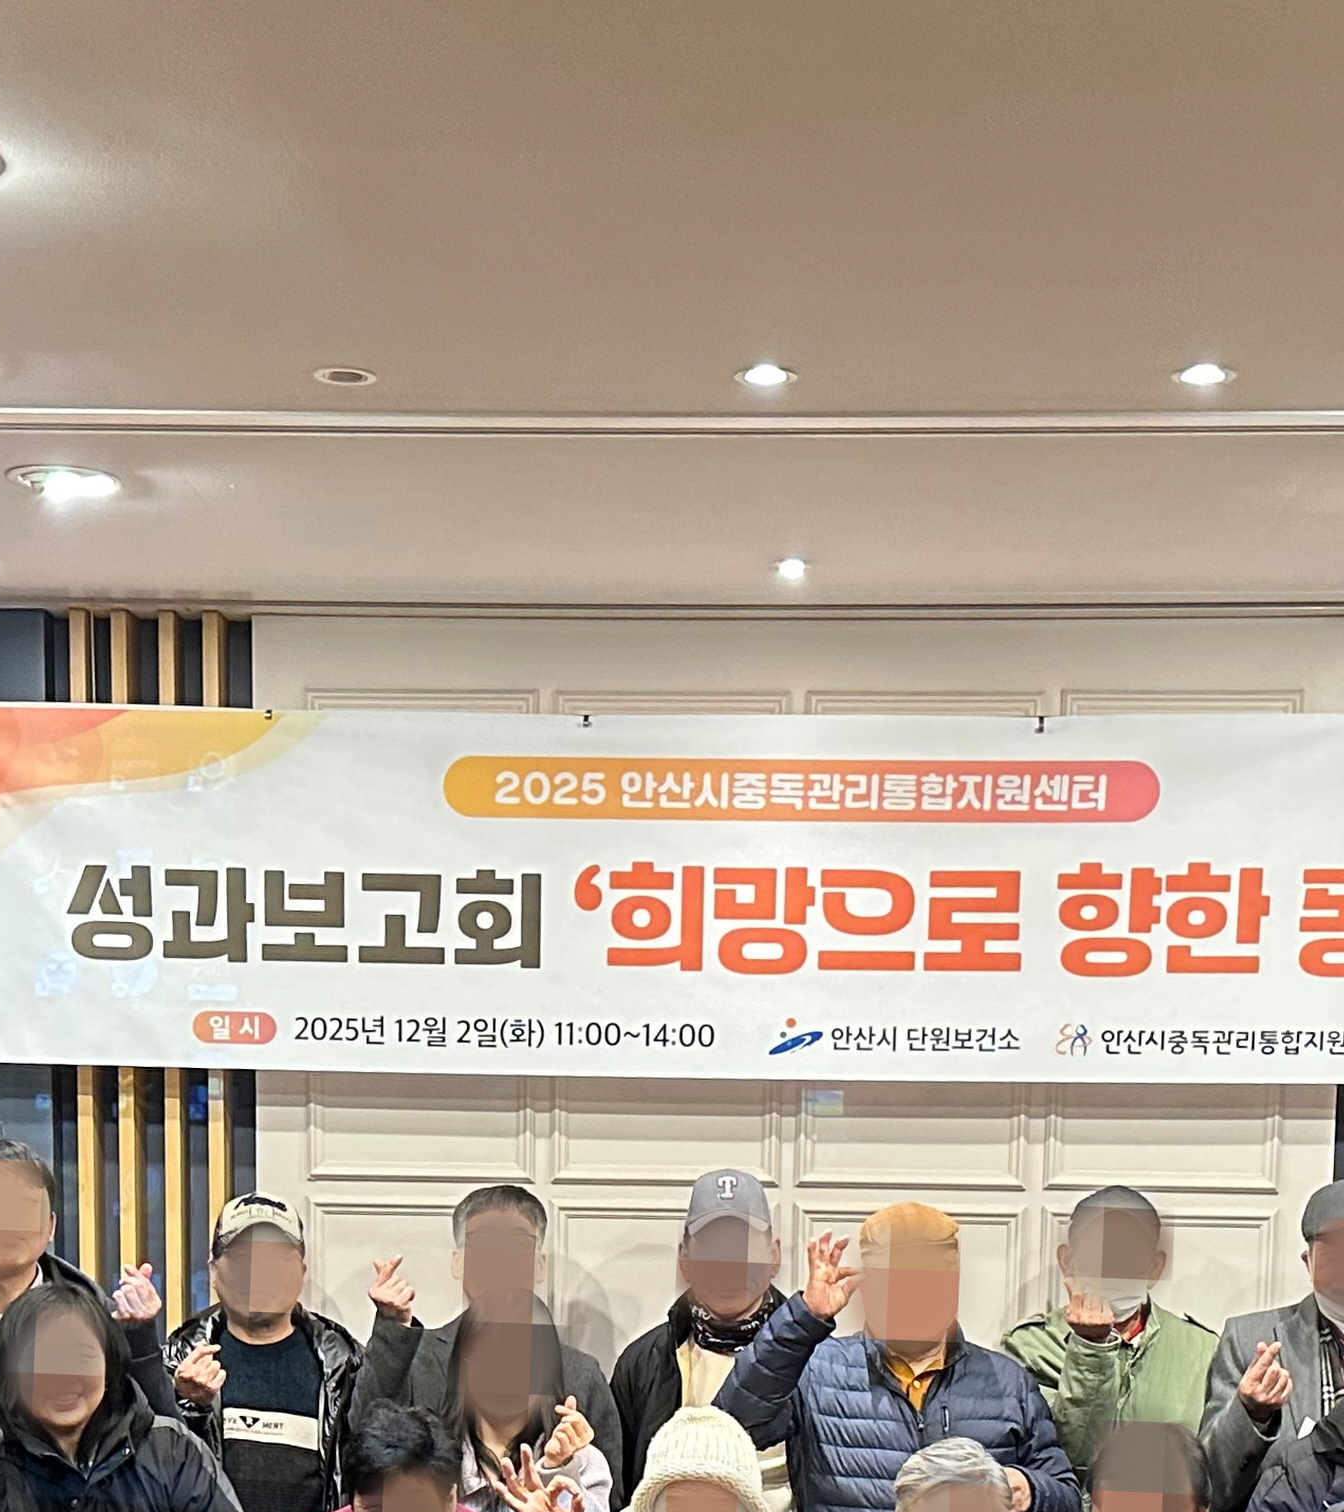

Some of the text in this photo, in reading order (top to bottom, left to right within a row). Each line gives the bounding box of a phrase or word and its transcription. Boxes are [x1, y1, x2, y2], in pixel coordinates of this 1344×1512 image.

[494, 770, 1108, 813] 2025 안산시중독관리통합지원센터
[66, 863, 543, 970] 성과보고회
[1056, 861, 1272, 979] 향한
[294, 1015, 386, 1046] 2025년
[394, 1016, 448, 1048] 12월
[455, 1017, 546, 1050] 2일(화)
[554, 1021, 716, 1049] 11:00~14:00
[831, 1025, 1021, 1054] 안산시 단원보건소
[717, 1175, 739, 1201] T
